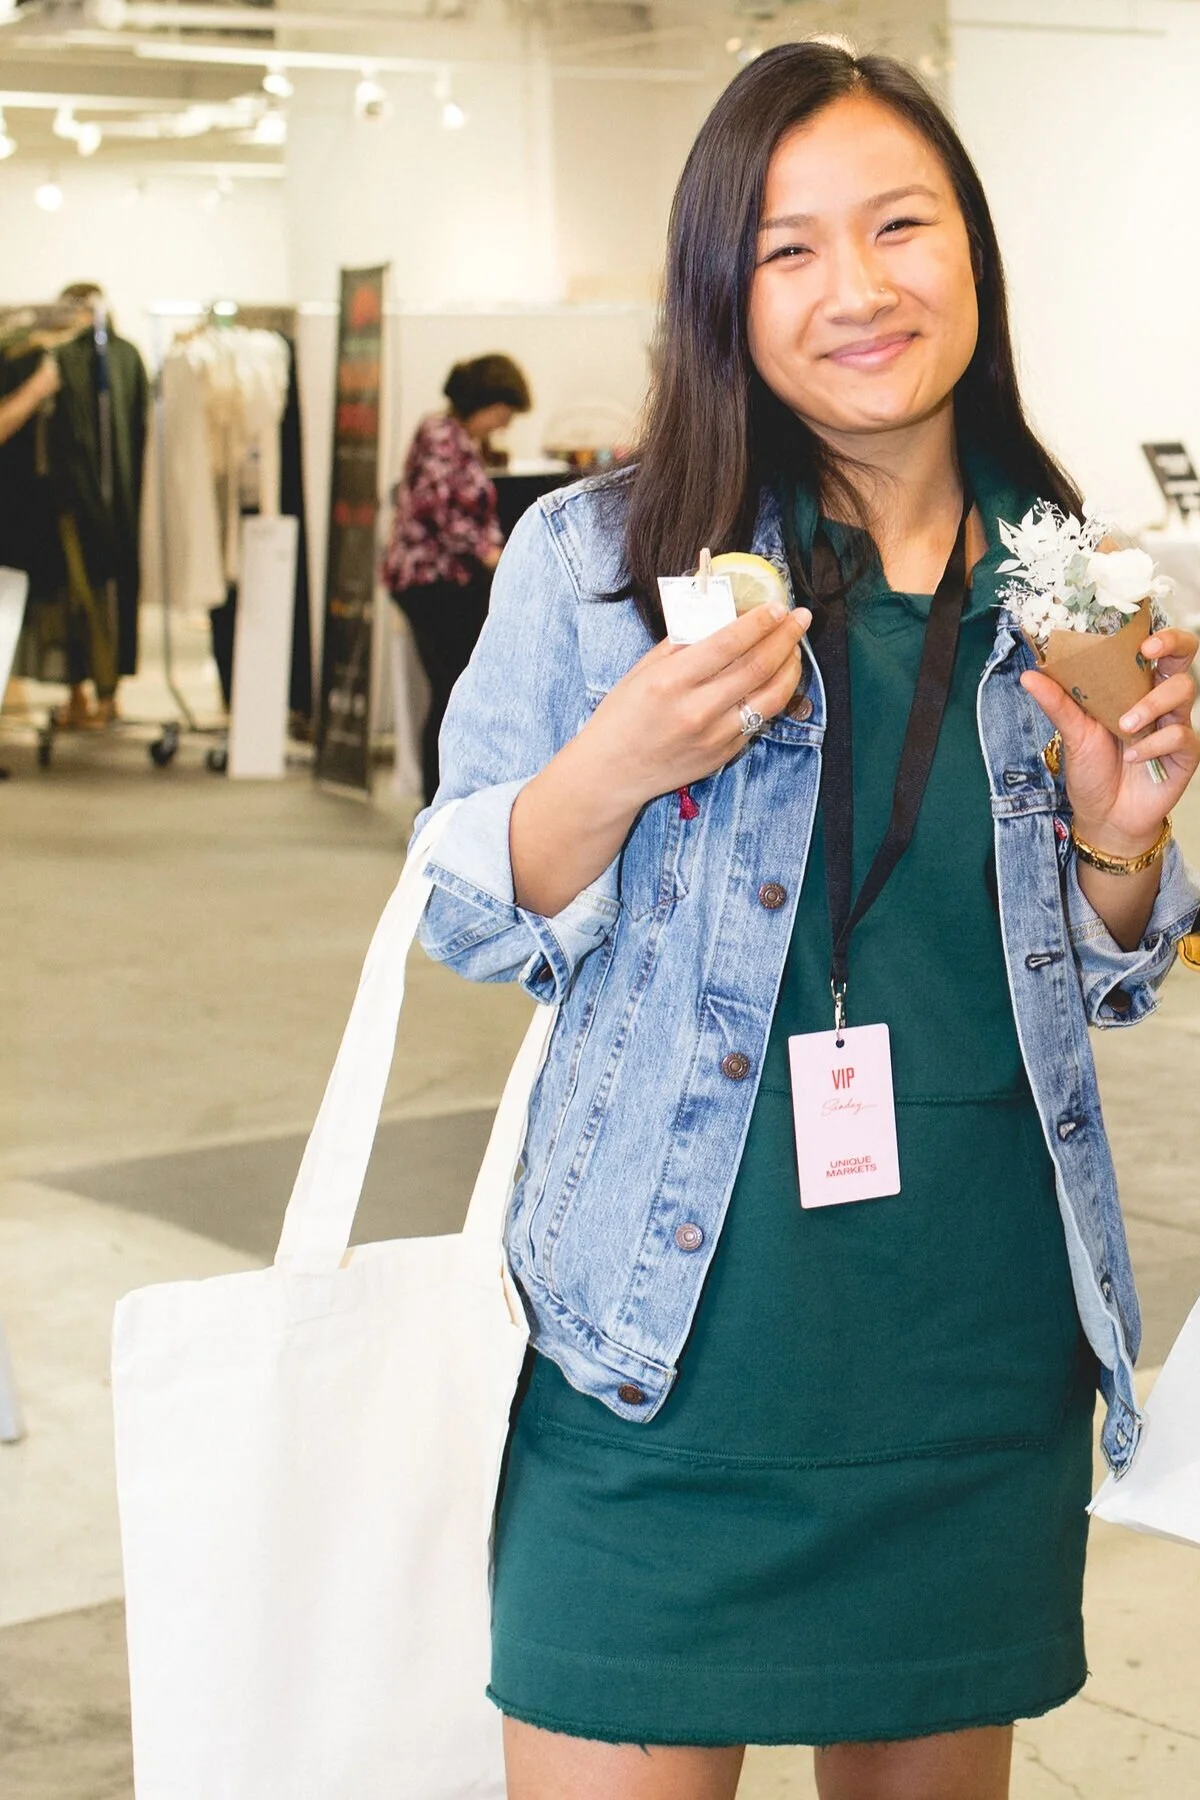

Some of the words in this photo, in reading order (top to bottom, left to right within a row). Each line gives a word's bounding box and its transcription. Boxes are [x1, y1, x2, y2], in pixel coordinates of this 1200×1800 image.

[832, 1067, 855, 1090] VIP
[821, 1098, 877, 1117] Sunday
[826, 1163, 877, 1178] MARKETS
[830, 1155, 872, 1169] UNIQUE
